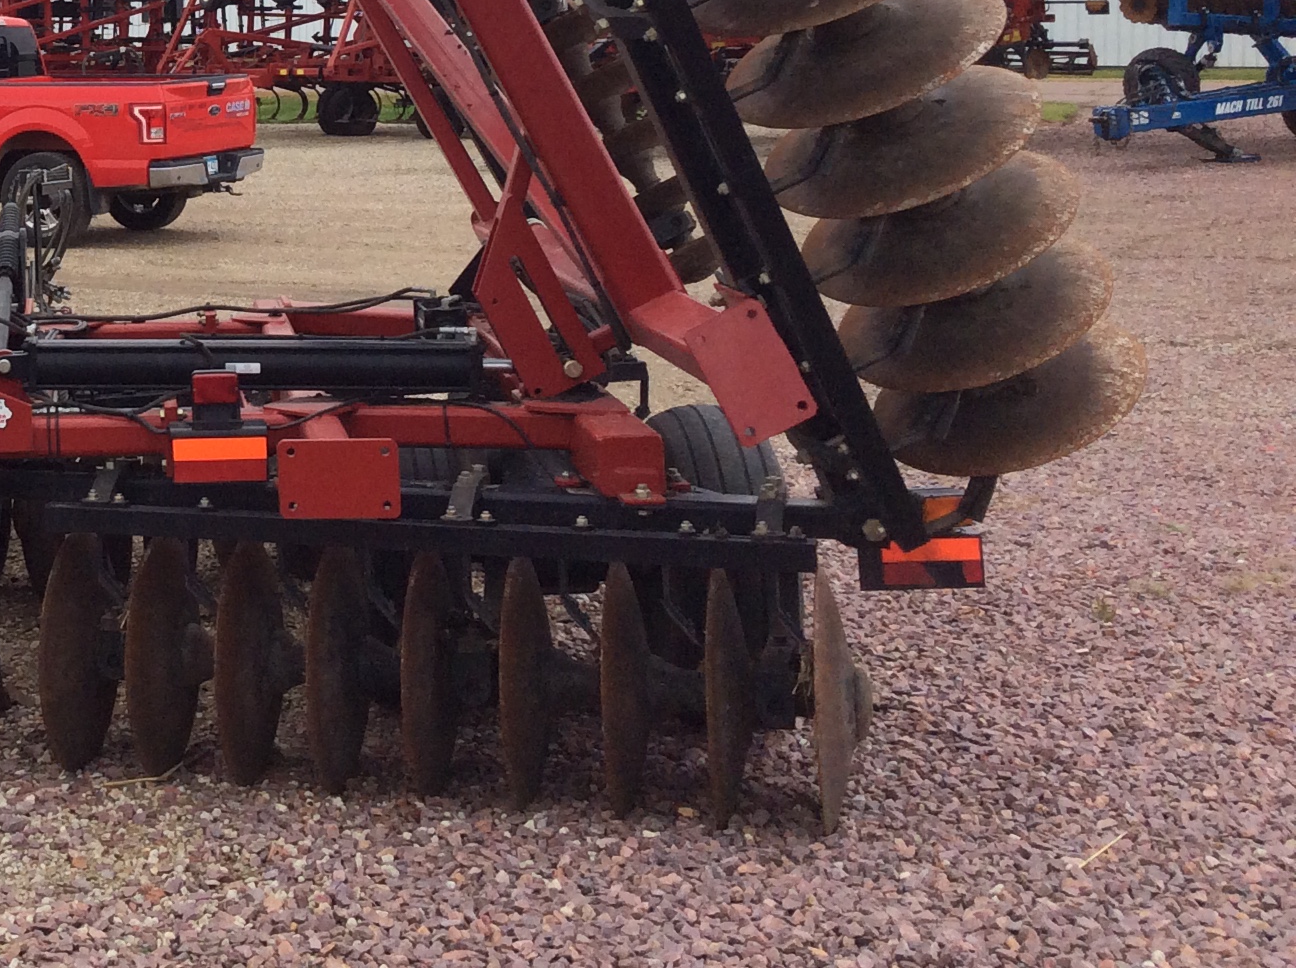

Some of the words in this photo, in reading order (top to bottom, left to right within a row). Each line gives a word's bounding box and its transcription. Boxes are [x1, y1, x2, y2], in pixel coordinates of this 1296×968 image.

[226, 100, 244, 113] CASE
[1215, 102, 1242, 115] MACH
[1245, 99, 1263, 111] TILL
[1266, 95, 1283, 108] 261
